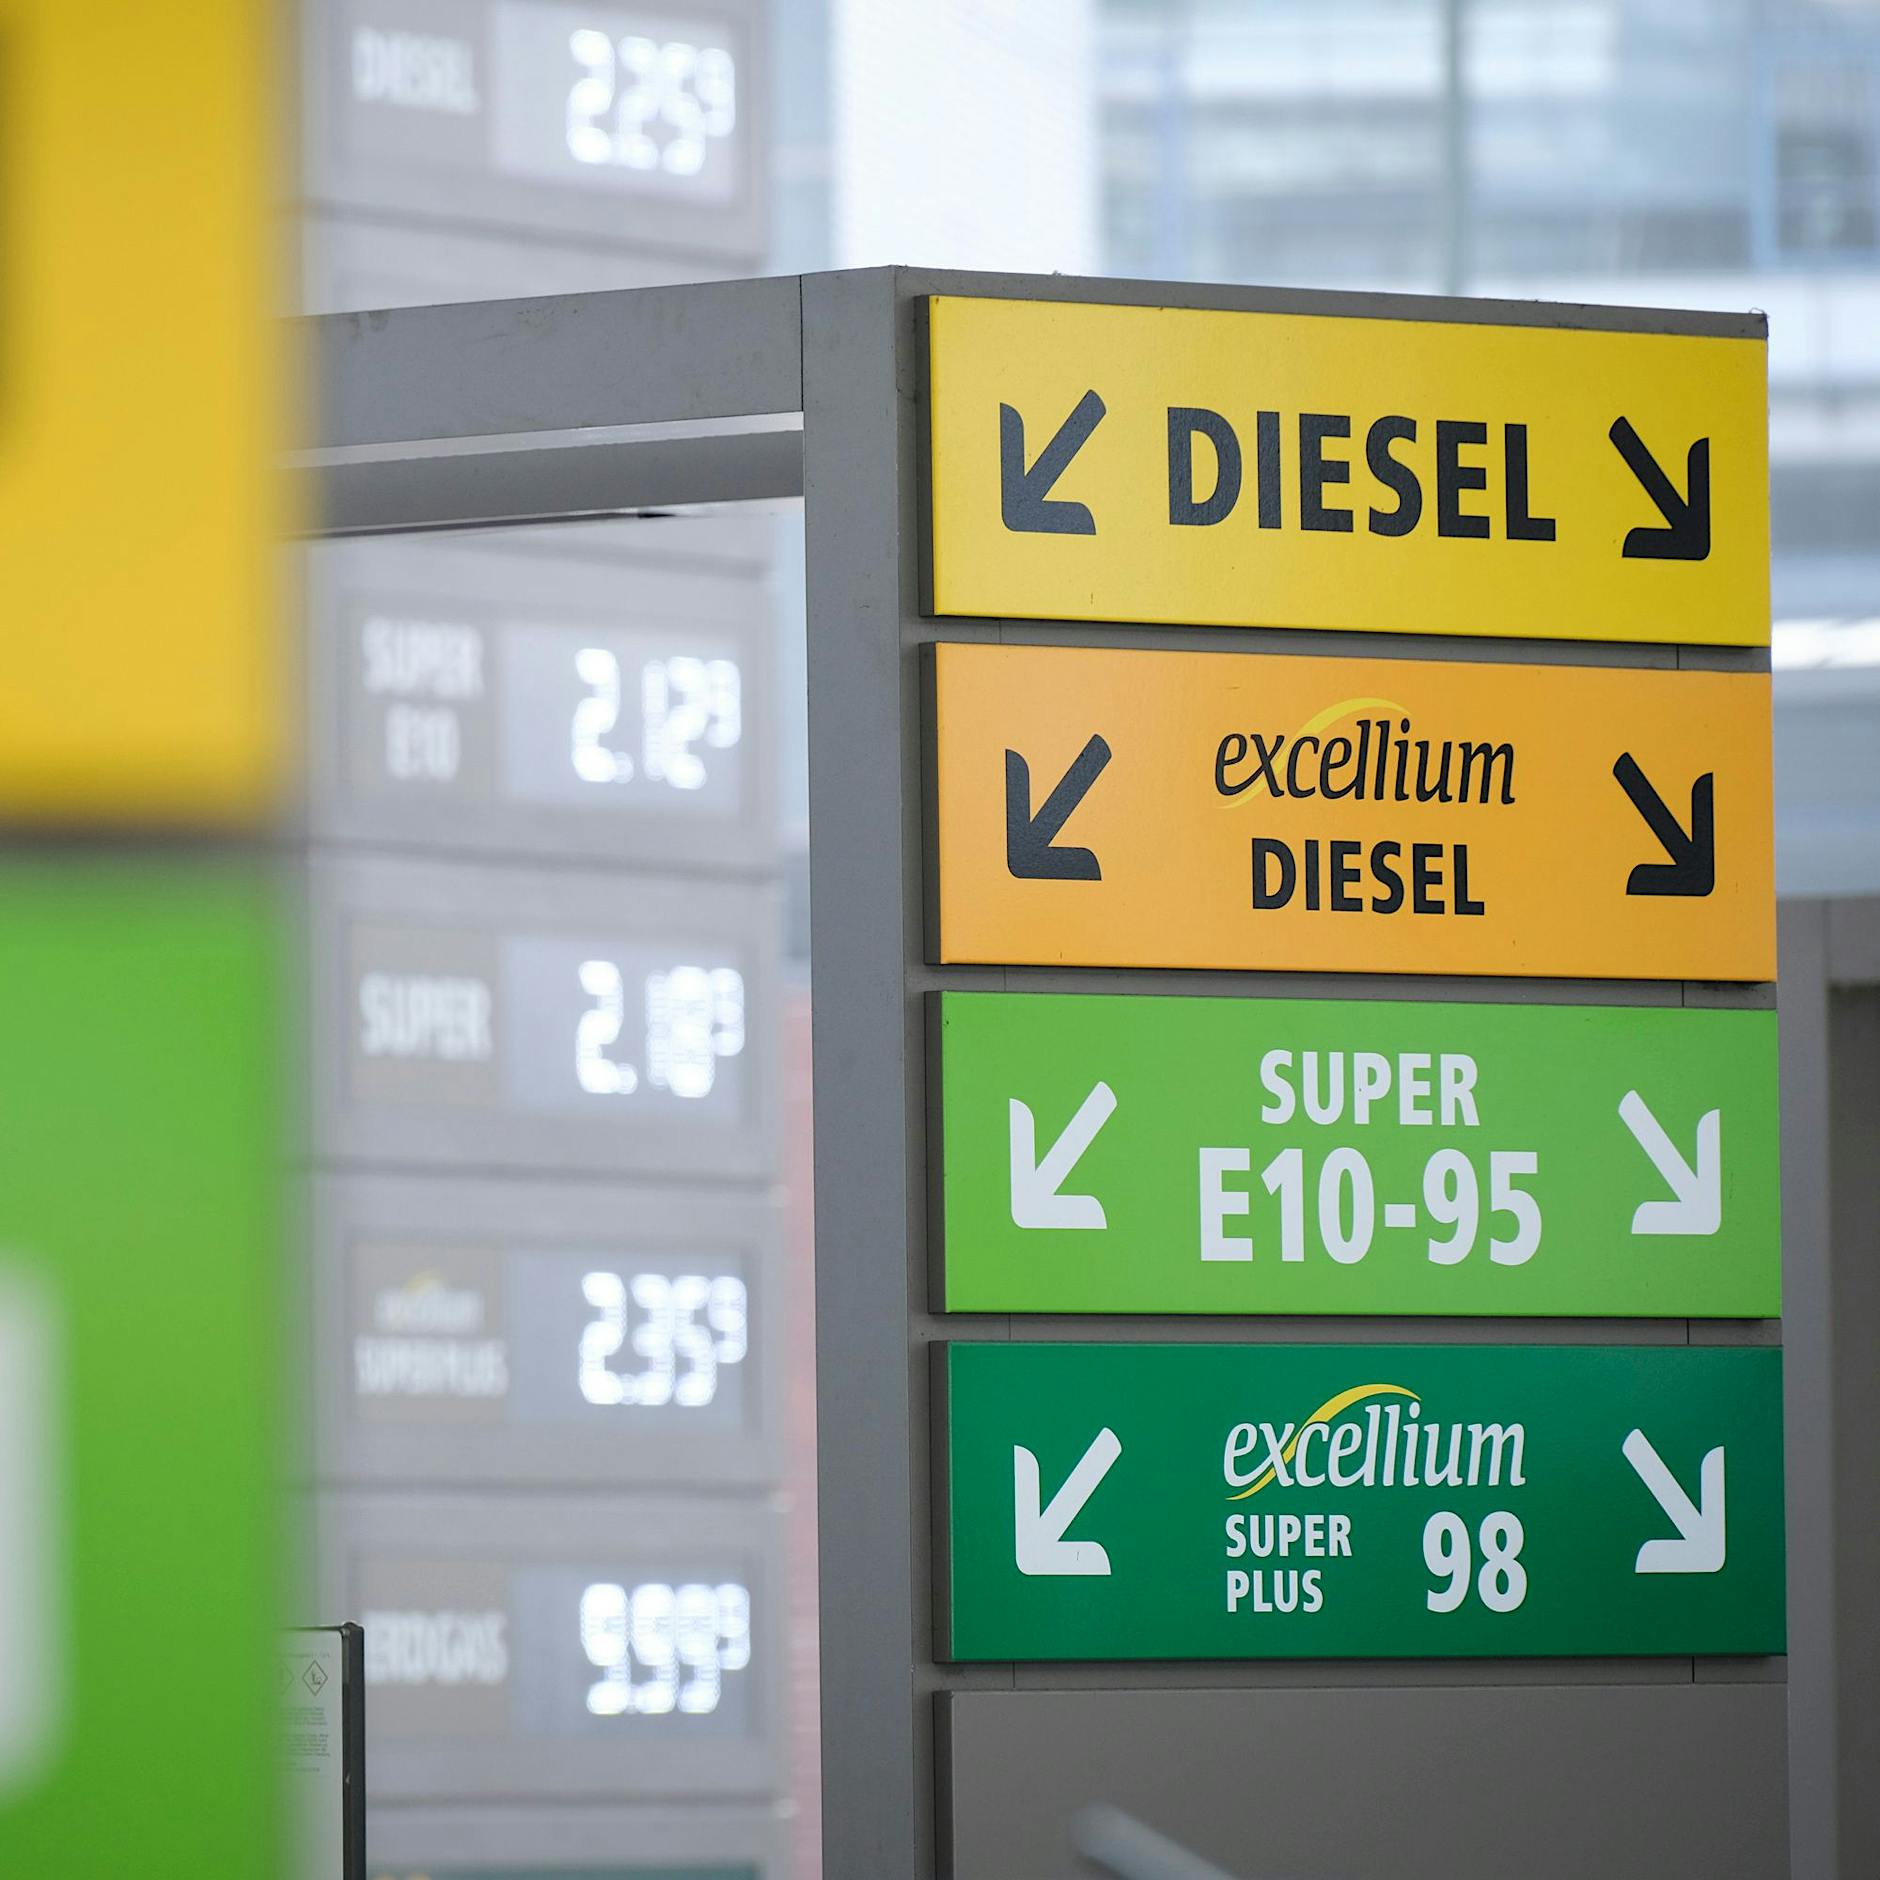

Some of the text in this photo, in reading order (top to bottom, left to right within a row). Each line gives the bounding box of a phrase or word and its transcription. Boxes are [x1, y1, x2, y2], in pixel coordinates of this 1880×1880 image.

[1167, 406, 1557, 542] DIESEL
[1214, 716, 1517, 806] excellium
[1251, 837, 1486, 916] DIESEL
[1259, 1048, 1481, 1127] SUPER
[1198, 1146, 1543, 1266] E10-95
[1222, 1400, 1527, 1488] excellium
[1225, 1513, 1353, 1558] SUPER
[1422, 1510, 1528, 1614] 98
[1226, 1568, 1324, 1613] PLUS
